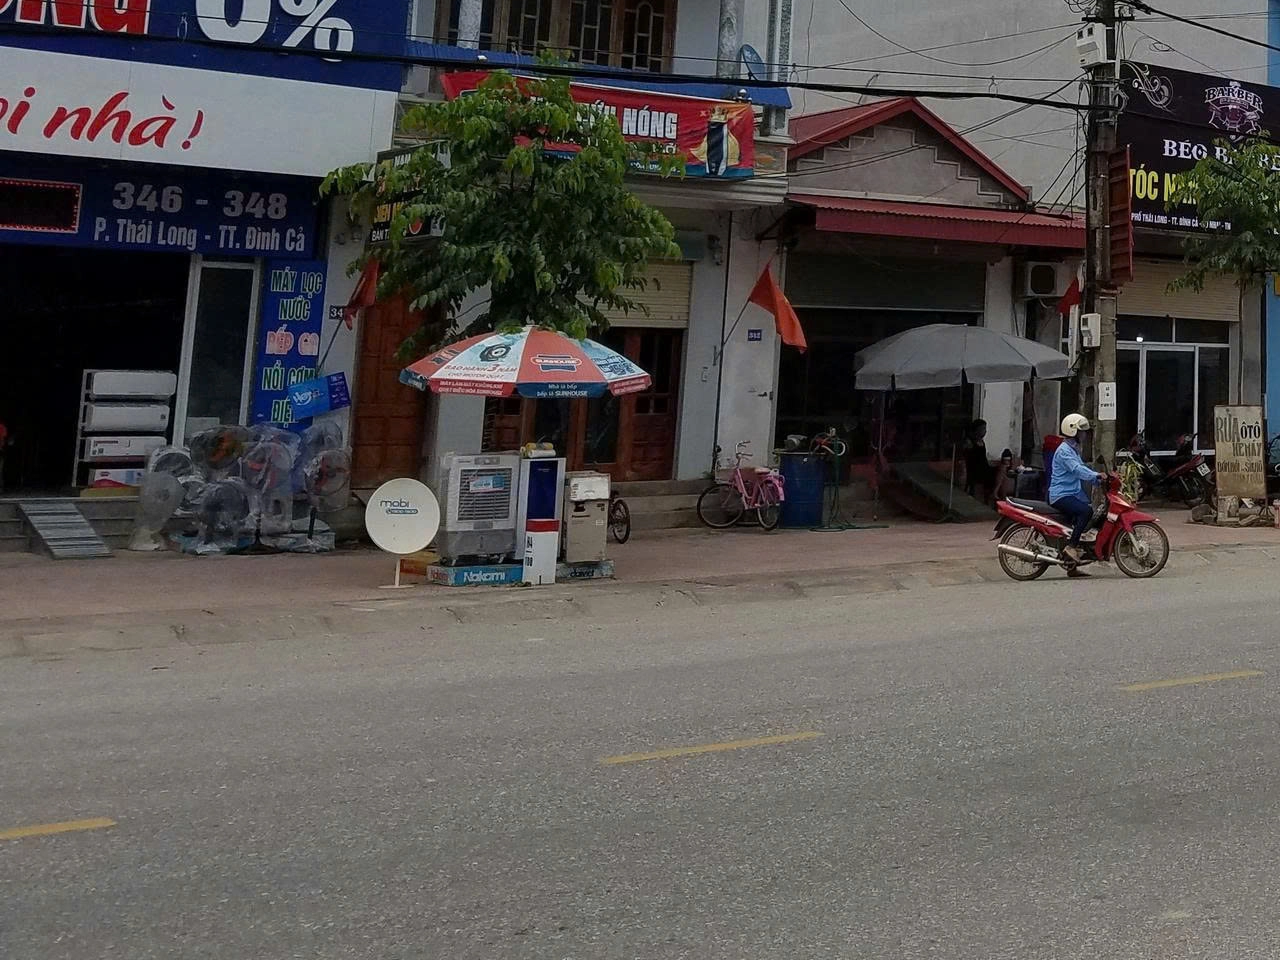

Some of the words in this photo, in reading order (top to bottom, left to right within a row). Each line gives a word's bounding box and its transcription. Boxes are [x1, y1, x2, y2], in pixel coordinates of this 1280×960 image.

[1206, 87, 1261, 109] BARBER
[43, 92, 206, 151] nhà!
[622, 105, 678, 139] NÓNG
[1162, 139, 1208, 161] BÉO
[113, 182, 183, 213] 346
[223, 190, 287, 220] 348
[95, 218, 113, 241] P.
[117, 218, 151, 244] Thái
[158, 222, 198, 251] Long
[218, 227, 241, 249] TT.
[245, 226, 280, 251] Đình
[271, 266, 297, 292] MÁY
[301, 271, 323, 298] LỌC
[279, 295, 310, 321] NƯỚC
[262, 359, 285, 390] NỒI
[271, 396, 296, 428] ĐIỆ
